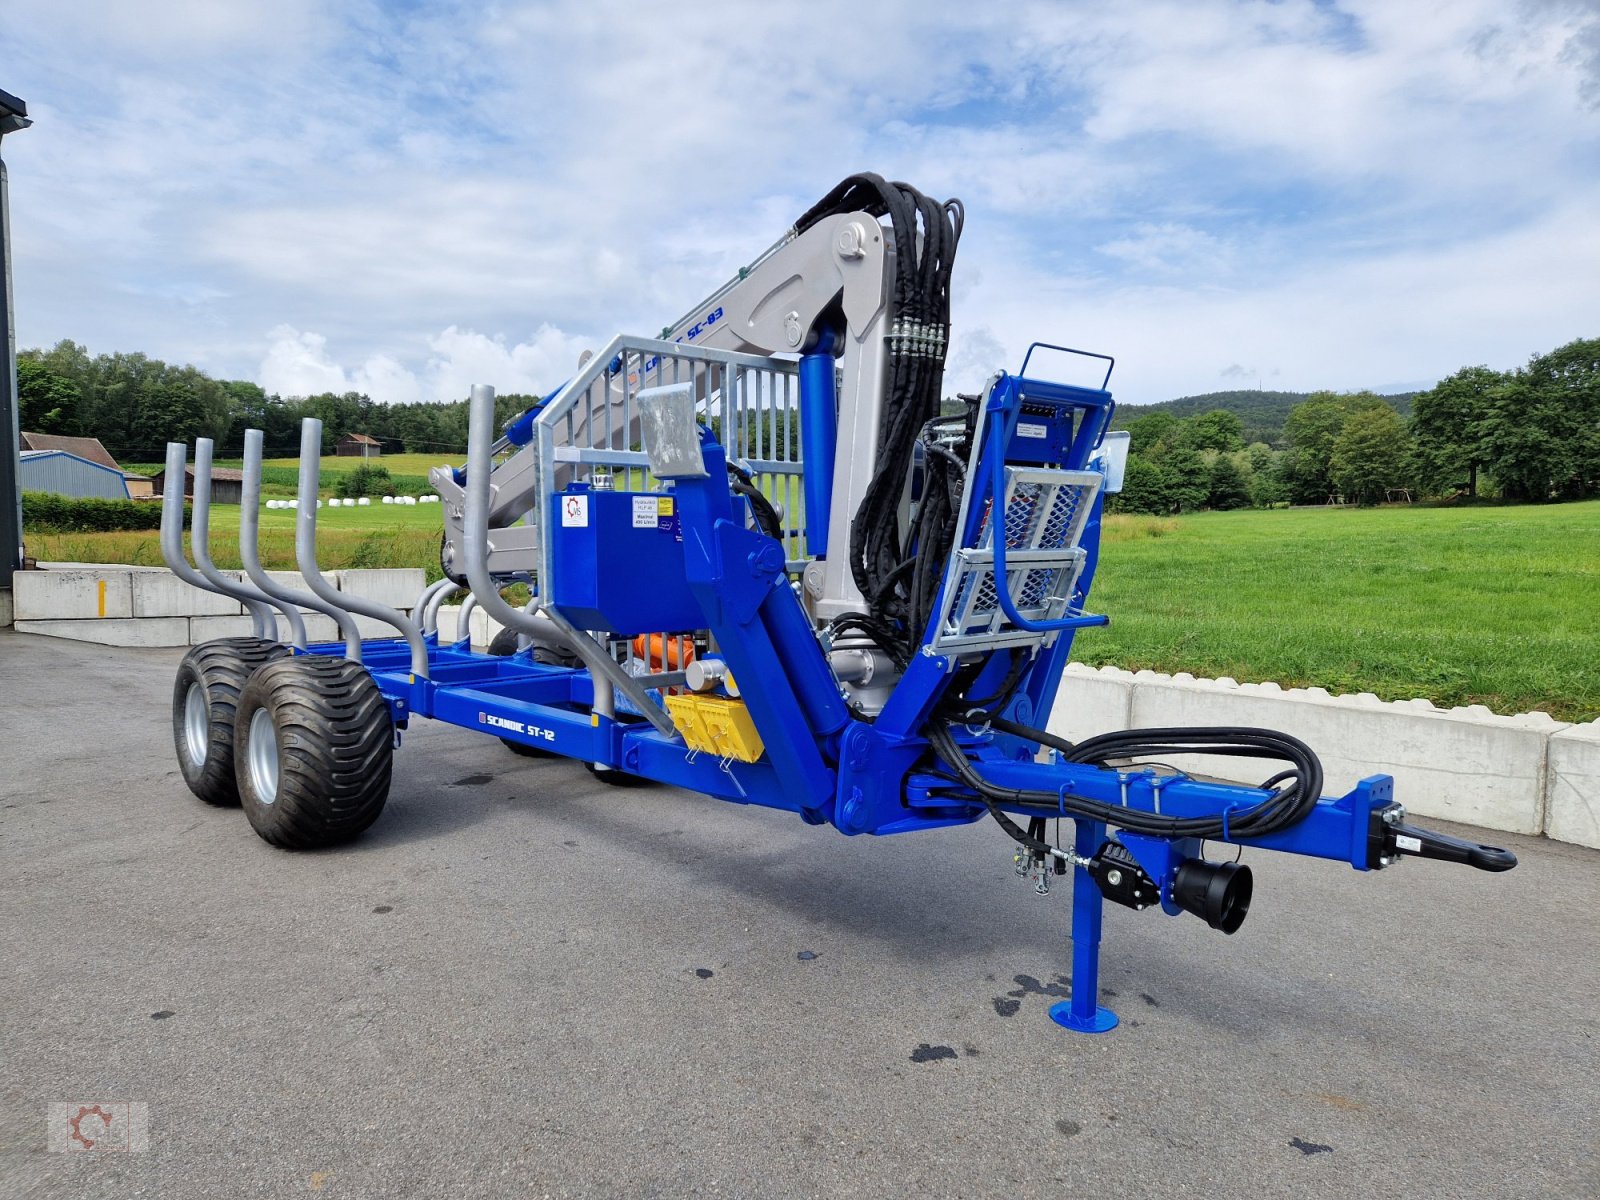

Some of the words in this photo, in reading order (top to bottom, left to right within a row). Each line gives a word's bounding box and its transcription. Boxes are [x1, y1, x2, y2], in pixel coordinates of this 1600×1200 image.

[687, 307, 723, 340] SC-83
[487, 715, 524, 733] SCANDIC
[527, 725, 555, 741] ST-12
